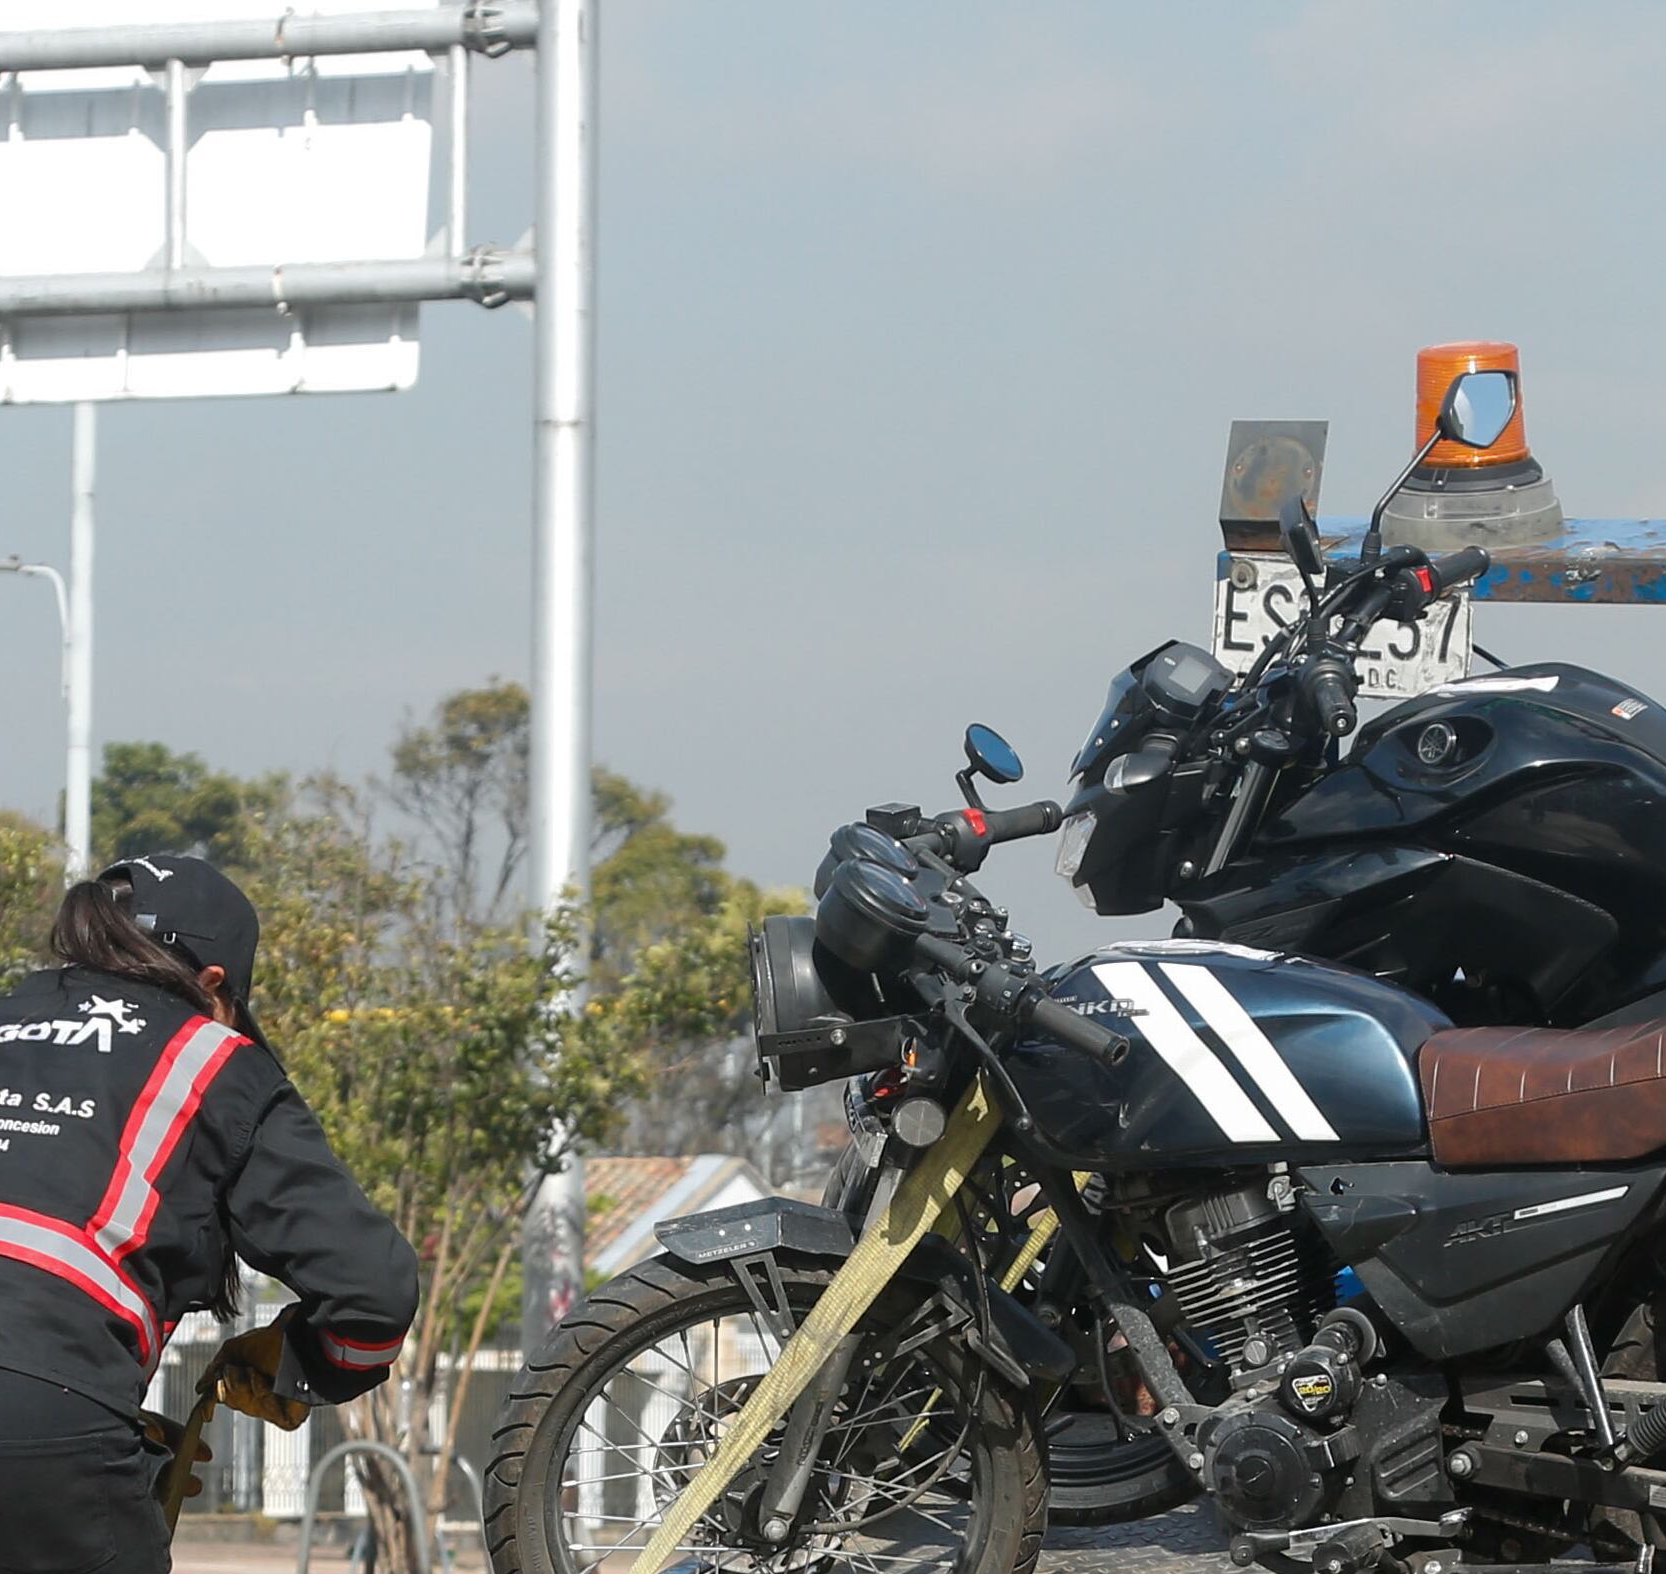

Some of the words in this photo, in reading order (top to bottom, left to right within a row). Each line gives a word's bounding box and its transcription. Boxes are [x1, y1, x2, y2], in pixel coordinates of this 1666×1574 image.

[1224, 578, 1325, 652] ES
[32, 1092, 96, 1118] S.A.S
[698, 1242, 748, 1258] METZELER
